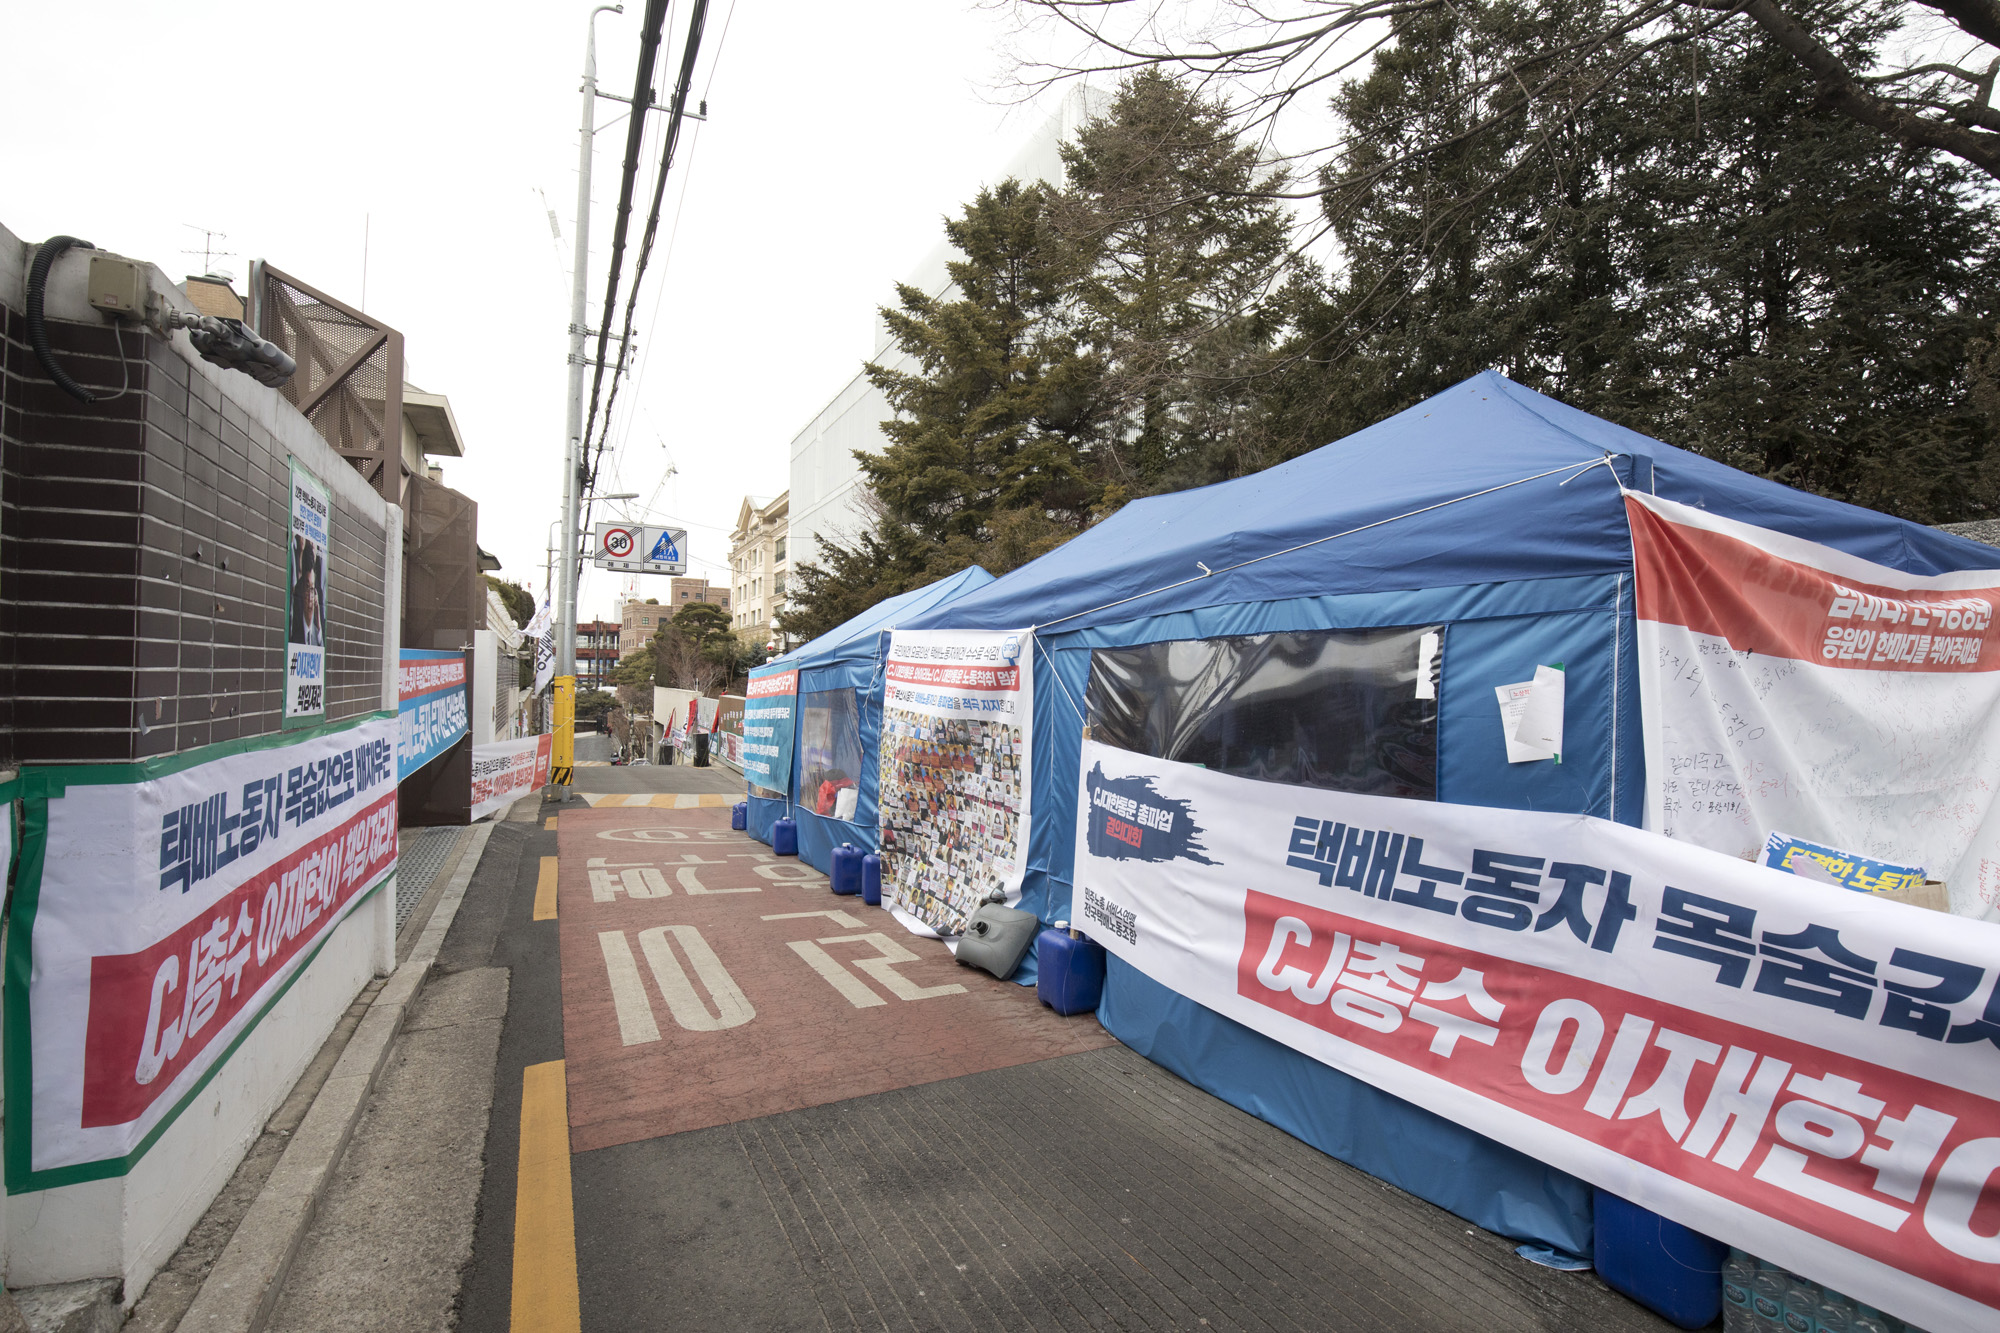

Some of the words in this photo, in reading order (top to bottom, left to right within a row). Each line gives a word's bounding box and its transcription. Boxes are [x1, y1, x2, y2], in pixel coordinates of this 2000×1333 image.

[611, 537, 627, 549] 30
[966, 646, 984, 660] 수수료
[1003, 643, 1017, 652] STOP
[1822, 626, 1876, 661] 응원의
[1872, 632, 1932, 664] 한마디를
[1929, 636, 1983, 664] 적어주세요!
[290, 651, 321, 679] #이재현이
[962, 670, 997, 686] 노동착취
[962, 698, 980, 712] 적극
[160, 773, 282, 894] 택배노동자
[284, 750, 354, 828] 목숨값으로
[356, 738, 390, 793] 배채우는
[1094, 786, 1138, 821] CJ대한통운
[1137, 803, 1174, 833] 총파업
[1106, 816, 1143, 848] 결의대회
[1285, 815, 1638, 954] 택배노동자
[1084, 902, 1137, 946] 전국택배노동조합
[1085, 887, 1105, 910] 민주노총
[1106, 900, 1137, 928] 서비스연맹
[135, 899, 254, 1085] CJ총수
[256, 834, 345, 968] 이재현이
[342, 798, 396, 888] 책임져라!
[1256, 915, 1507, 1060] CJ총수
